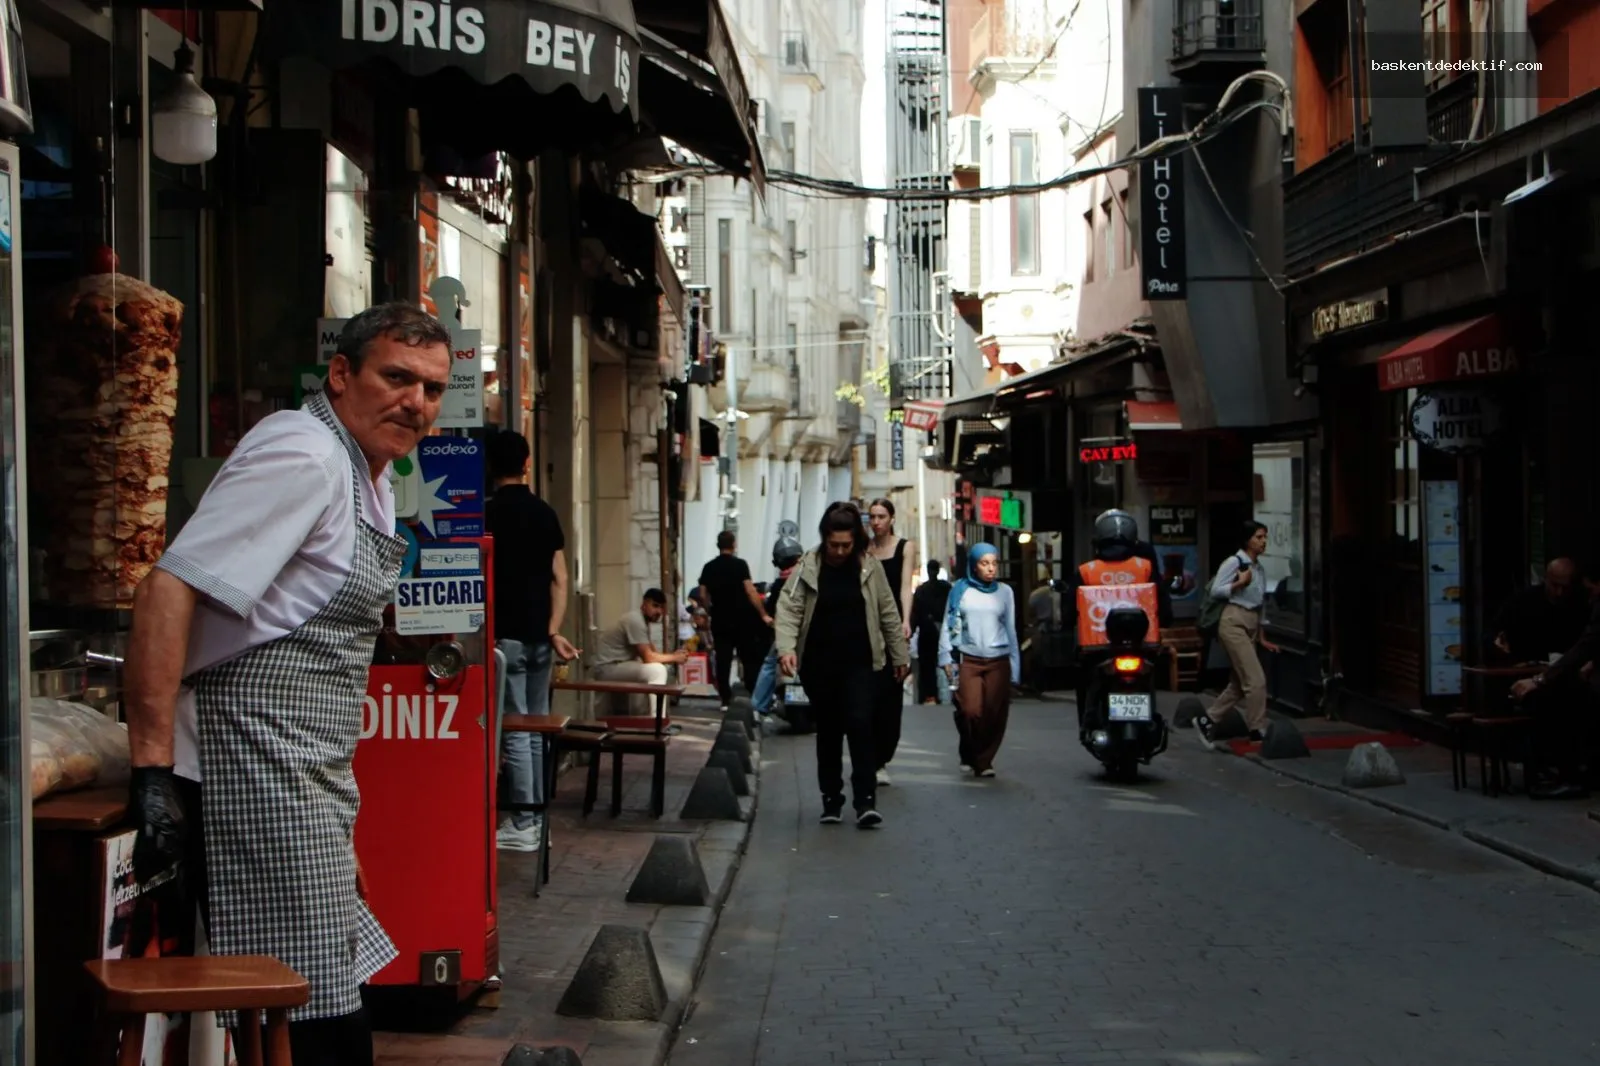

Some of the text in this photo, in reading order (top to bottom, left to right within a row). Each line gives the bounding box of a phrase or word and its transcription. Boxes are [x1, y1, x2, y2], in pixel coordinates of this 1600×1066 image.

[526, 18, 596, 75] BEY
[1455, 346, 1520, 376] ALBA
[452, 374, 476, 382] Ticket
[1438, 397, 1482, 417] ALBA
[1433, 419, 1482, 440] HOTEL
[422, 442, 479, 456] sodexo
[398, 580, 485, 607] SETCARD
[1111, 696, 1124, 705] 34
[1122, 707, 1141, 716] 747
